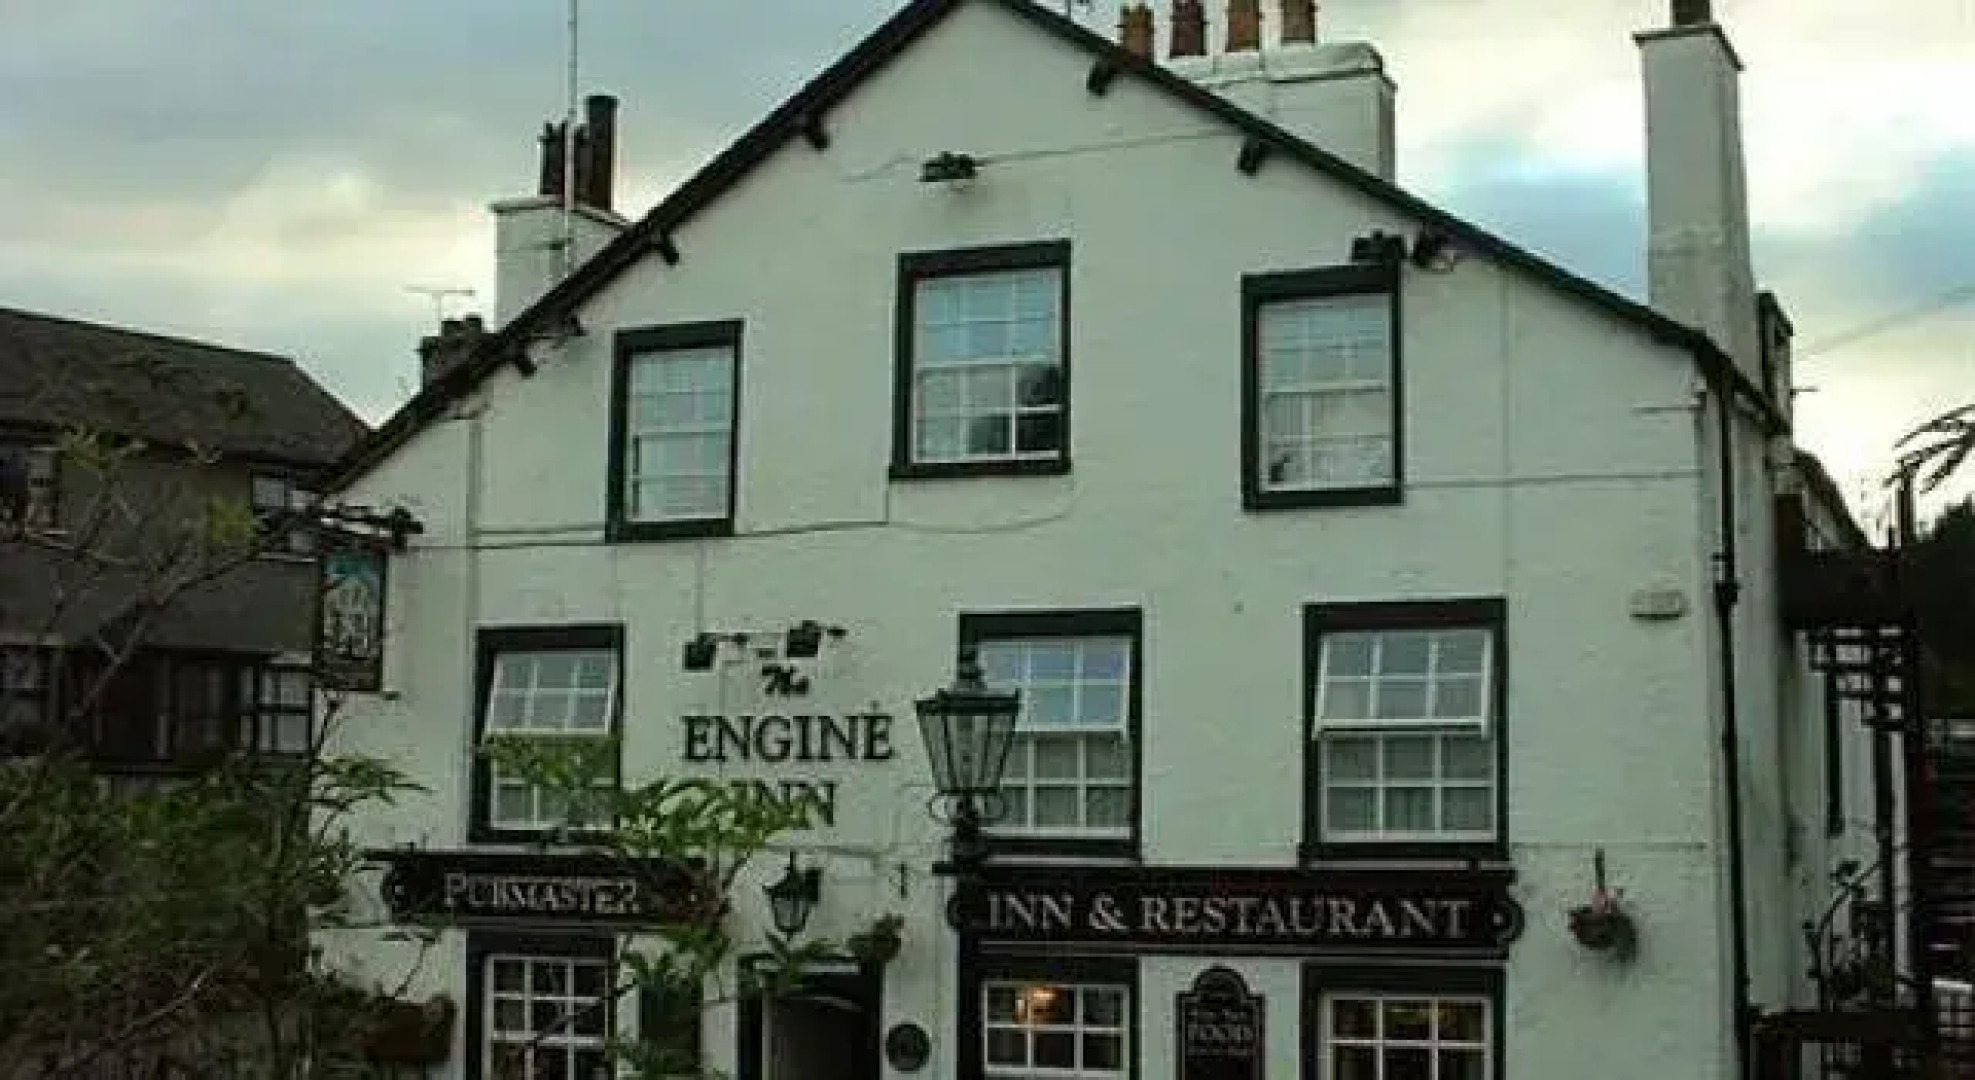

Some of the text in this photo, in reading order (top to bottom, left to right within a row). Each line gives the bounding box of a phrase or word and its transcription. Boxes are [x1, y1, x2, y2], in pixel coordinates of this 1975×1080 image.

[681, 714, 896, 762] ENGINE
[731, 779, 839, 829] INN
[987, 893, 1474, 938] INN & RESTAURANT
